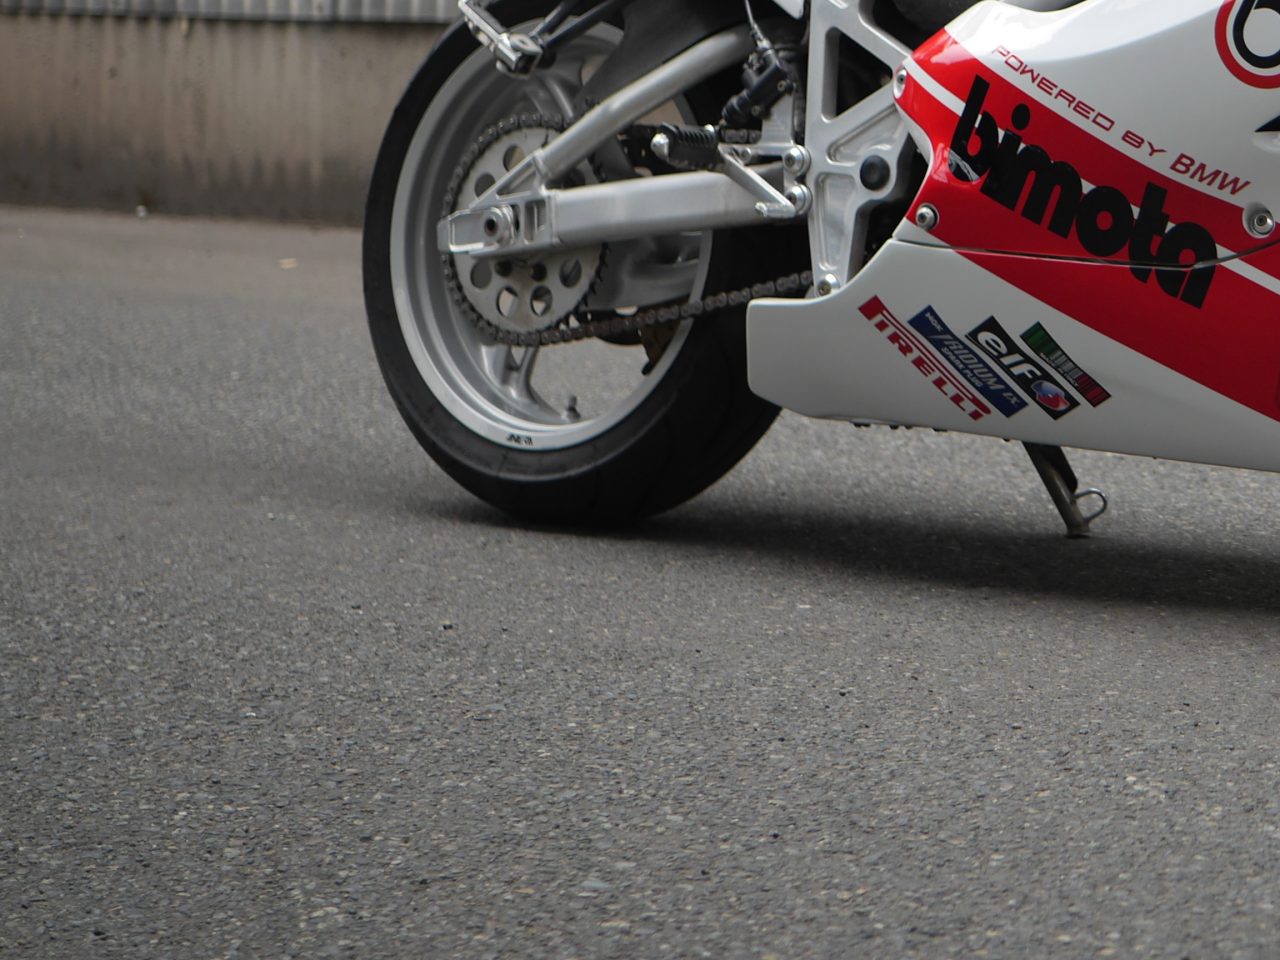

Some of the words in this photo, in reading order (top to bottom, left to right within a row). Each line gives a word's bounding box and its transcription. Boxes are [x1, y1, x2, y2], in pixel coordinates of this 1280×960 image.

[991, 44, 1115, 132] POWERED
[1121, 129, 1168, 157] BY
[1169, 152, 1252, 195] BMW
[948, 73, 1219, 310] bimota
[857, 294, 992, 421] PIRELLI
[926, 334, 1006, 391] IRIDIUM
